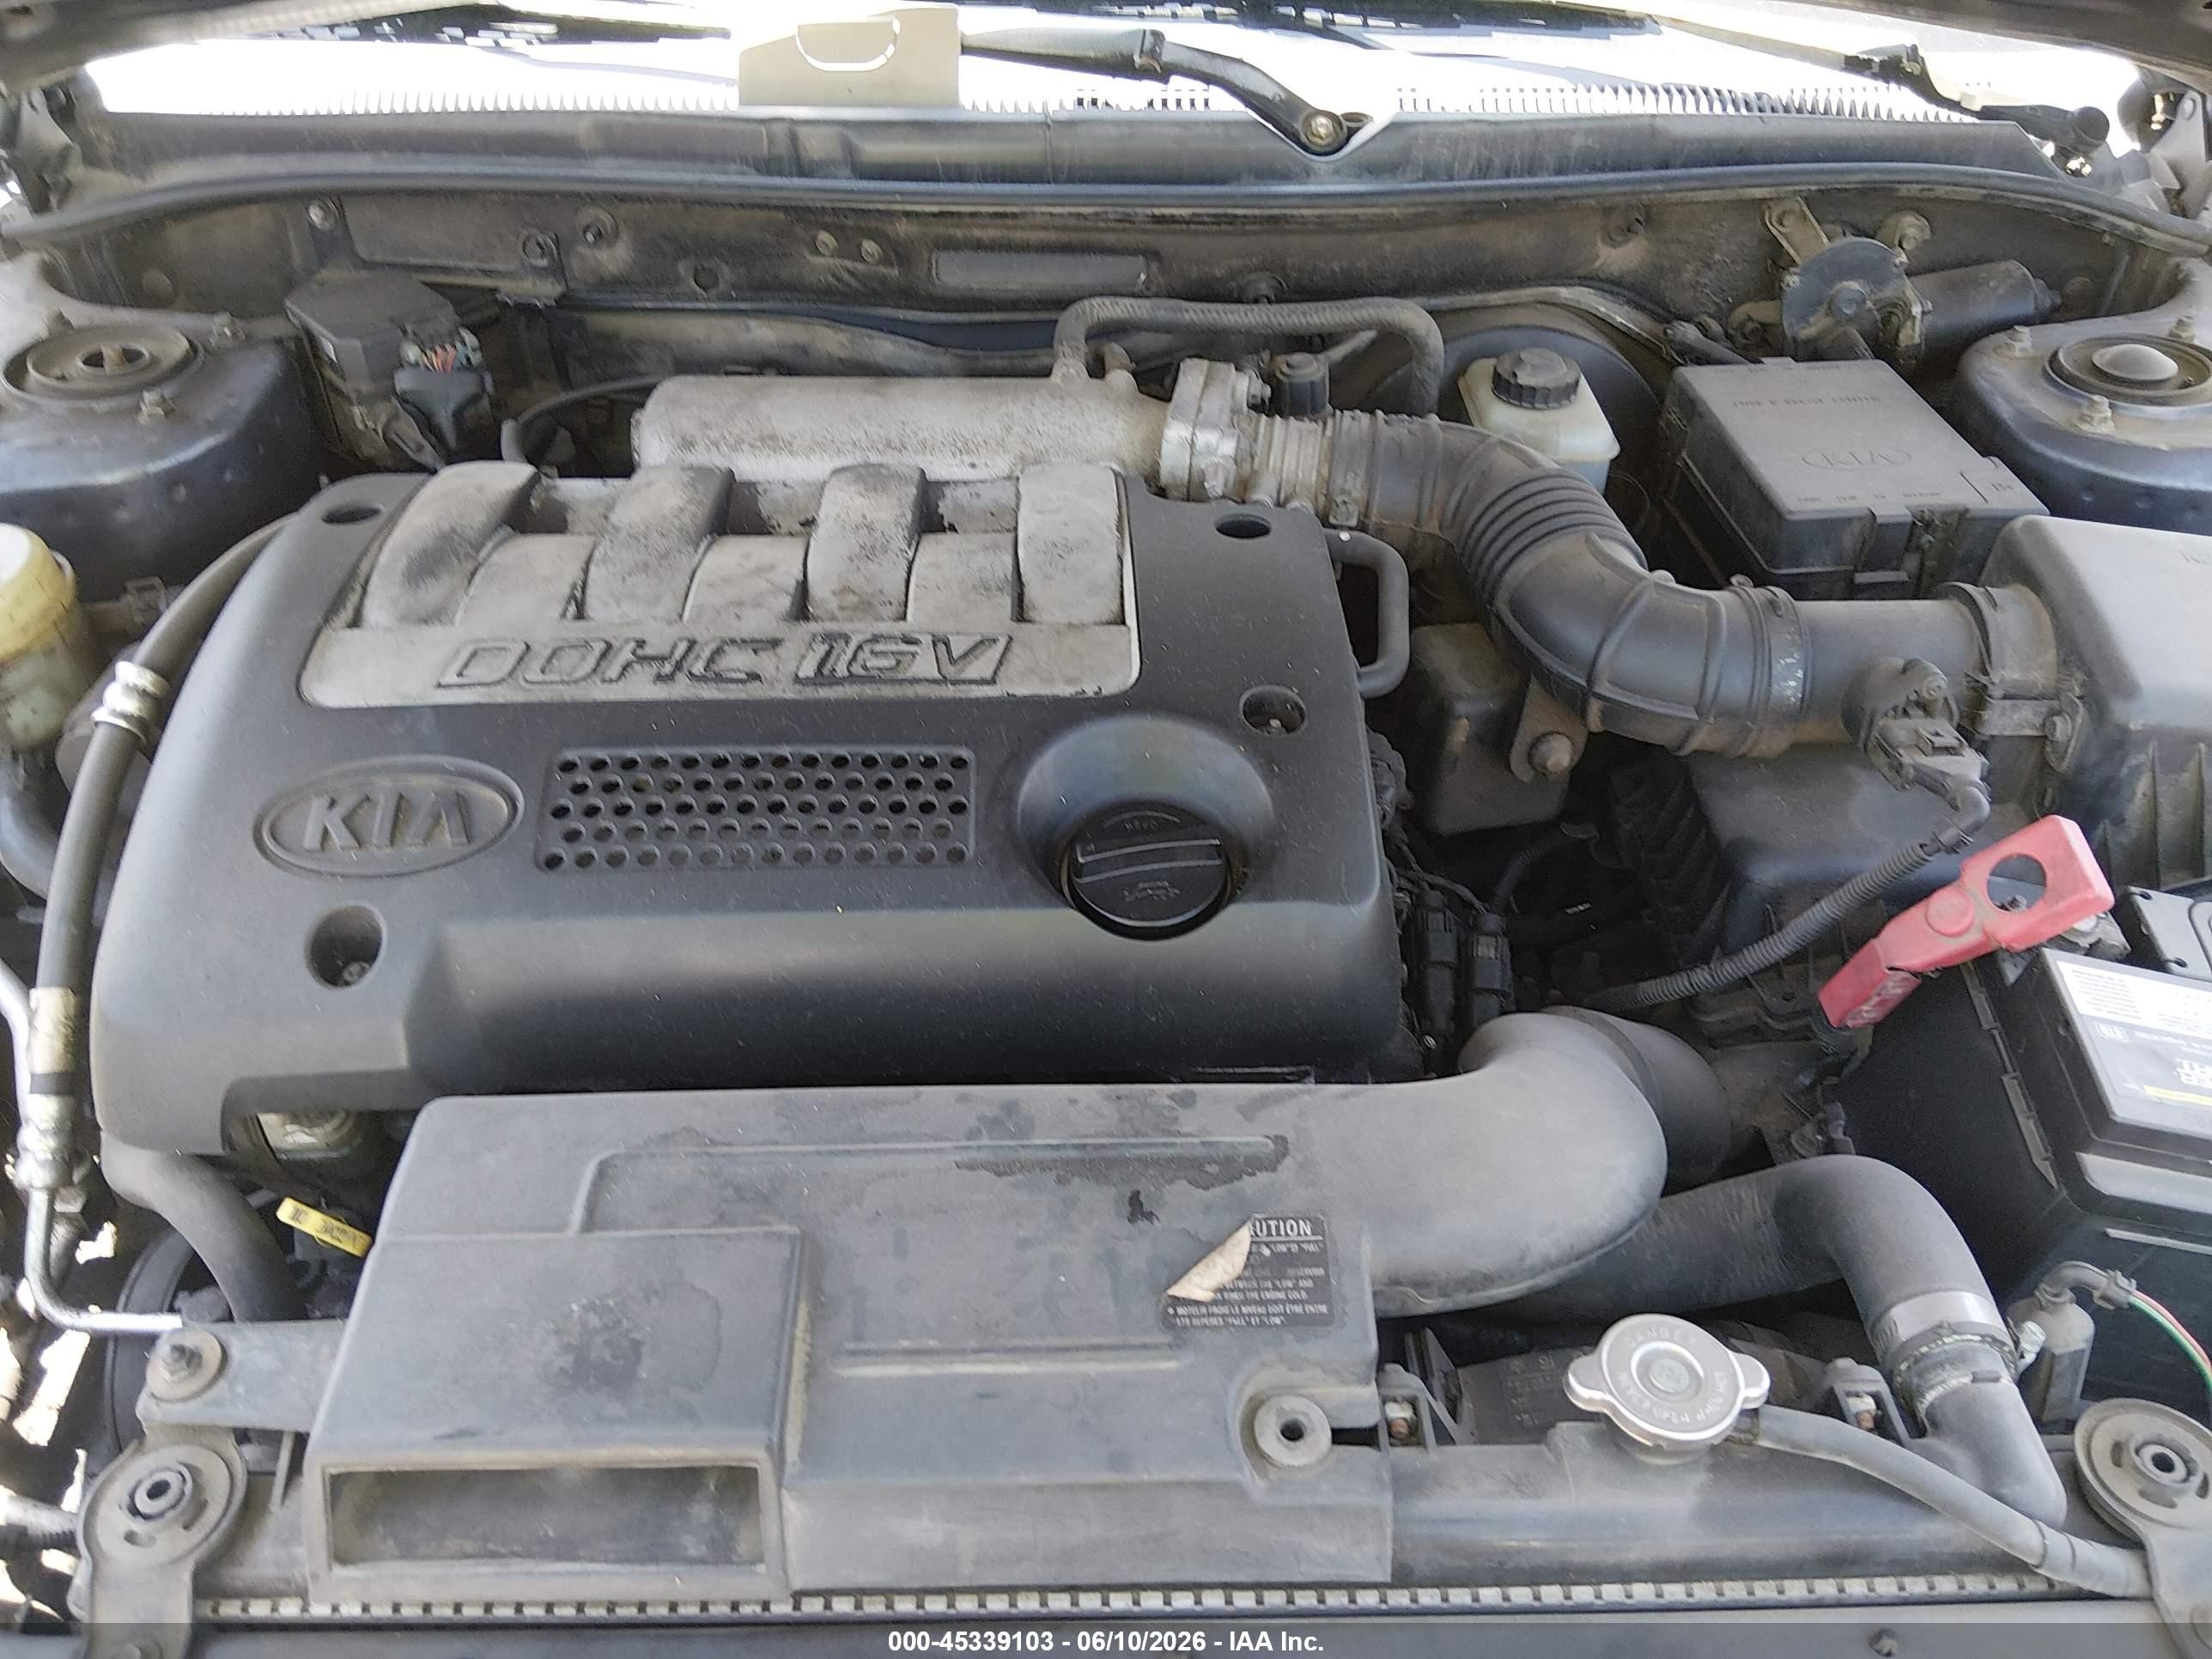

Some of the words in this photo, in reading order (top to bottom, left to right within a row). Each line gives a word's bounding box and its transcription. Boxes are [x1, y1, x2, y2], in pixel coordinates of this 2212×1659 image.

[437, 637, 781, 687] DOHC
[795, 633, 1013, 686] 16V
[302, 790, 471, 851] KIA
[1249, 1218, 1312, 1237] UTION
